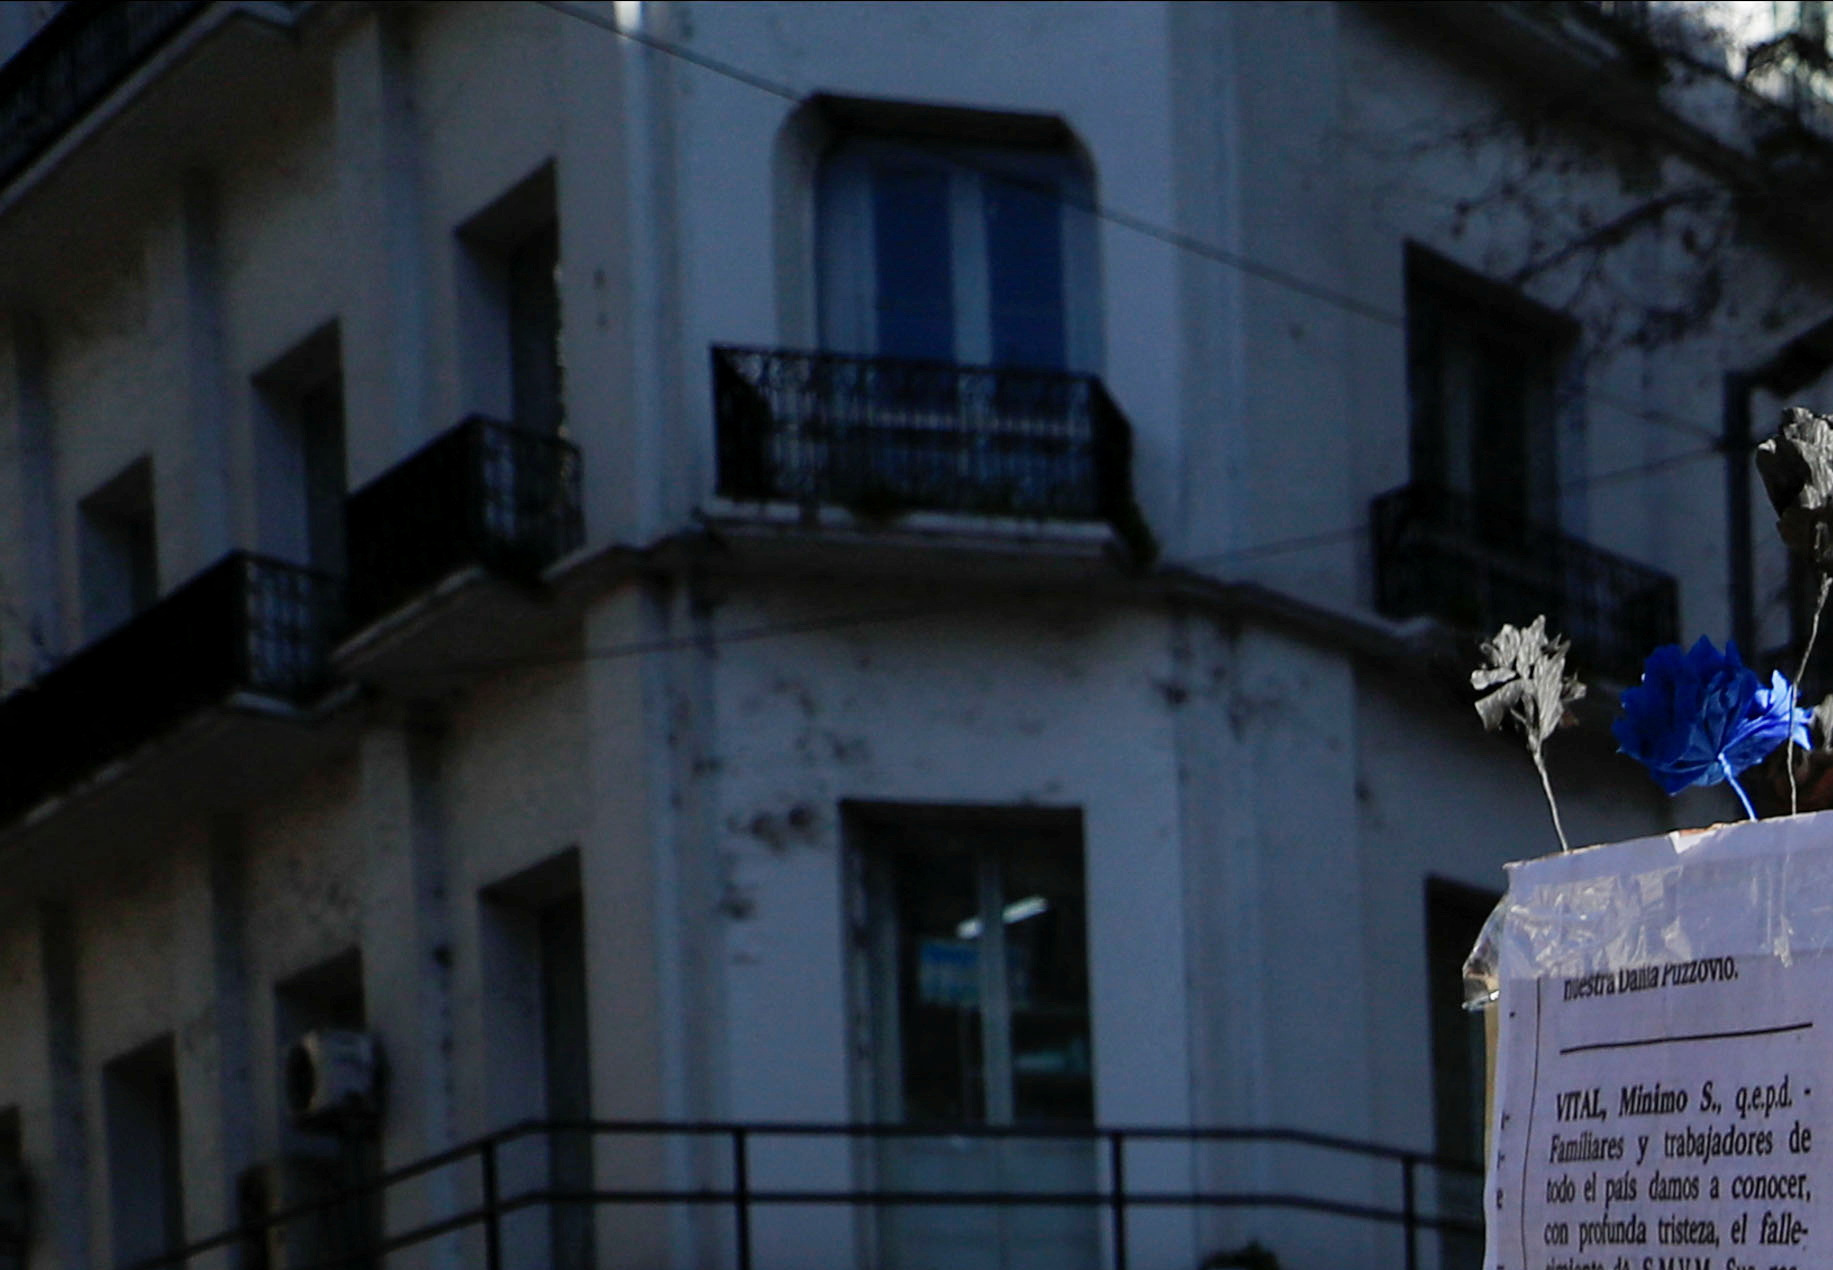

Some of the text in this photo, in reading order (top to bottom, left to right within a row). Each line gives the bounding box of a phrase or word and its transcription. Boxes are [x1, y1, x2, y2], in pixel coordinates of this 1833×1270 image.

[1562, 970, 1616, 1001] nuestra
[1557, 1087, 1607, 1122] VITAL,
[1700, 1080, 1722, 1115] S.,
[1735, 1074, 1792, 1120] q.e.p.d.
[1549, 1120, 1812, 1167] Familiares y trabajadores de
[1546, 1169, 1811, 1210] todo el país damos a conocer,
[1544, 1210, 1808, 1253] con profunda tristeza, el falle-
